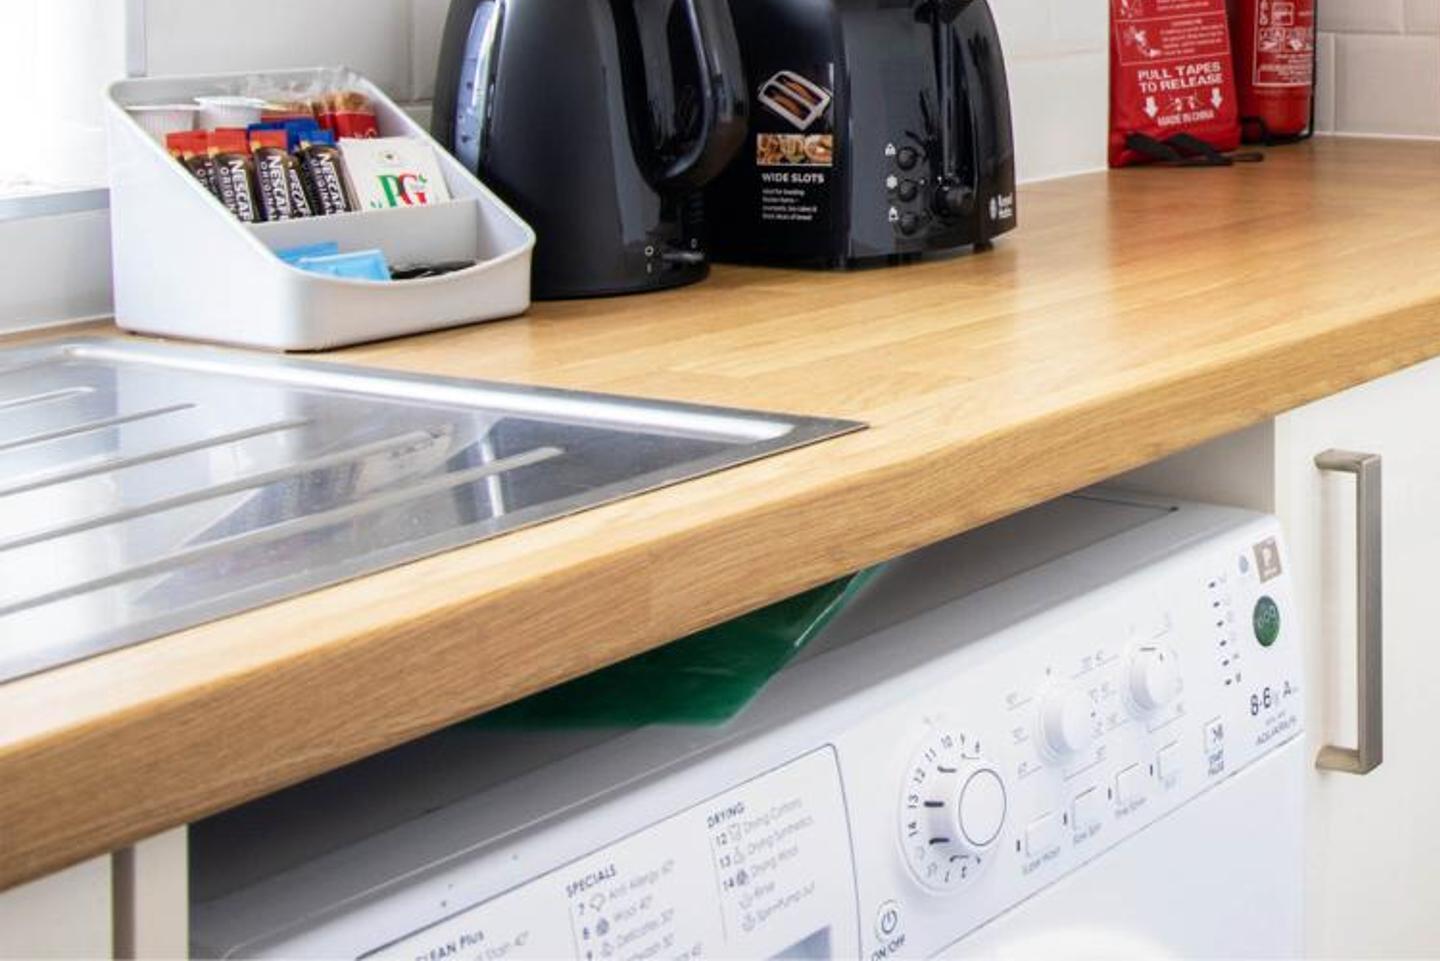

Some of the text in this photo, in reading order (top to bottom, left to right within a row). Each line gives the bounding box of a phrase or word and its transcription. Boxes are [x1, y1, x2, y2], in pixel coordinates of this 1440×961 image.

[1137, 61, 1221, 82] PULL TAPES
[1139, 73, 1223, 94] TO RELEASE
[227, 158, 255, 223] NESCAF
[376, 172, 428, 209] PG
[761, 172, 825, 184] WIDE SLOTS
[565, 862, 618, 898] SPECIALS
